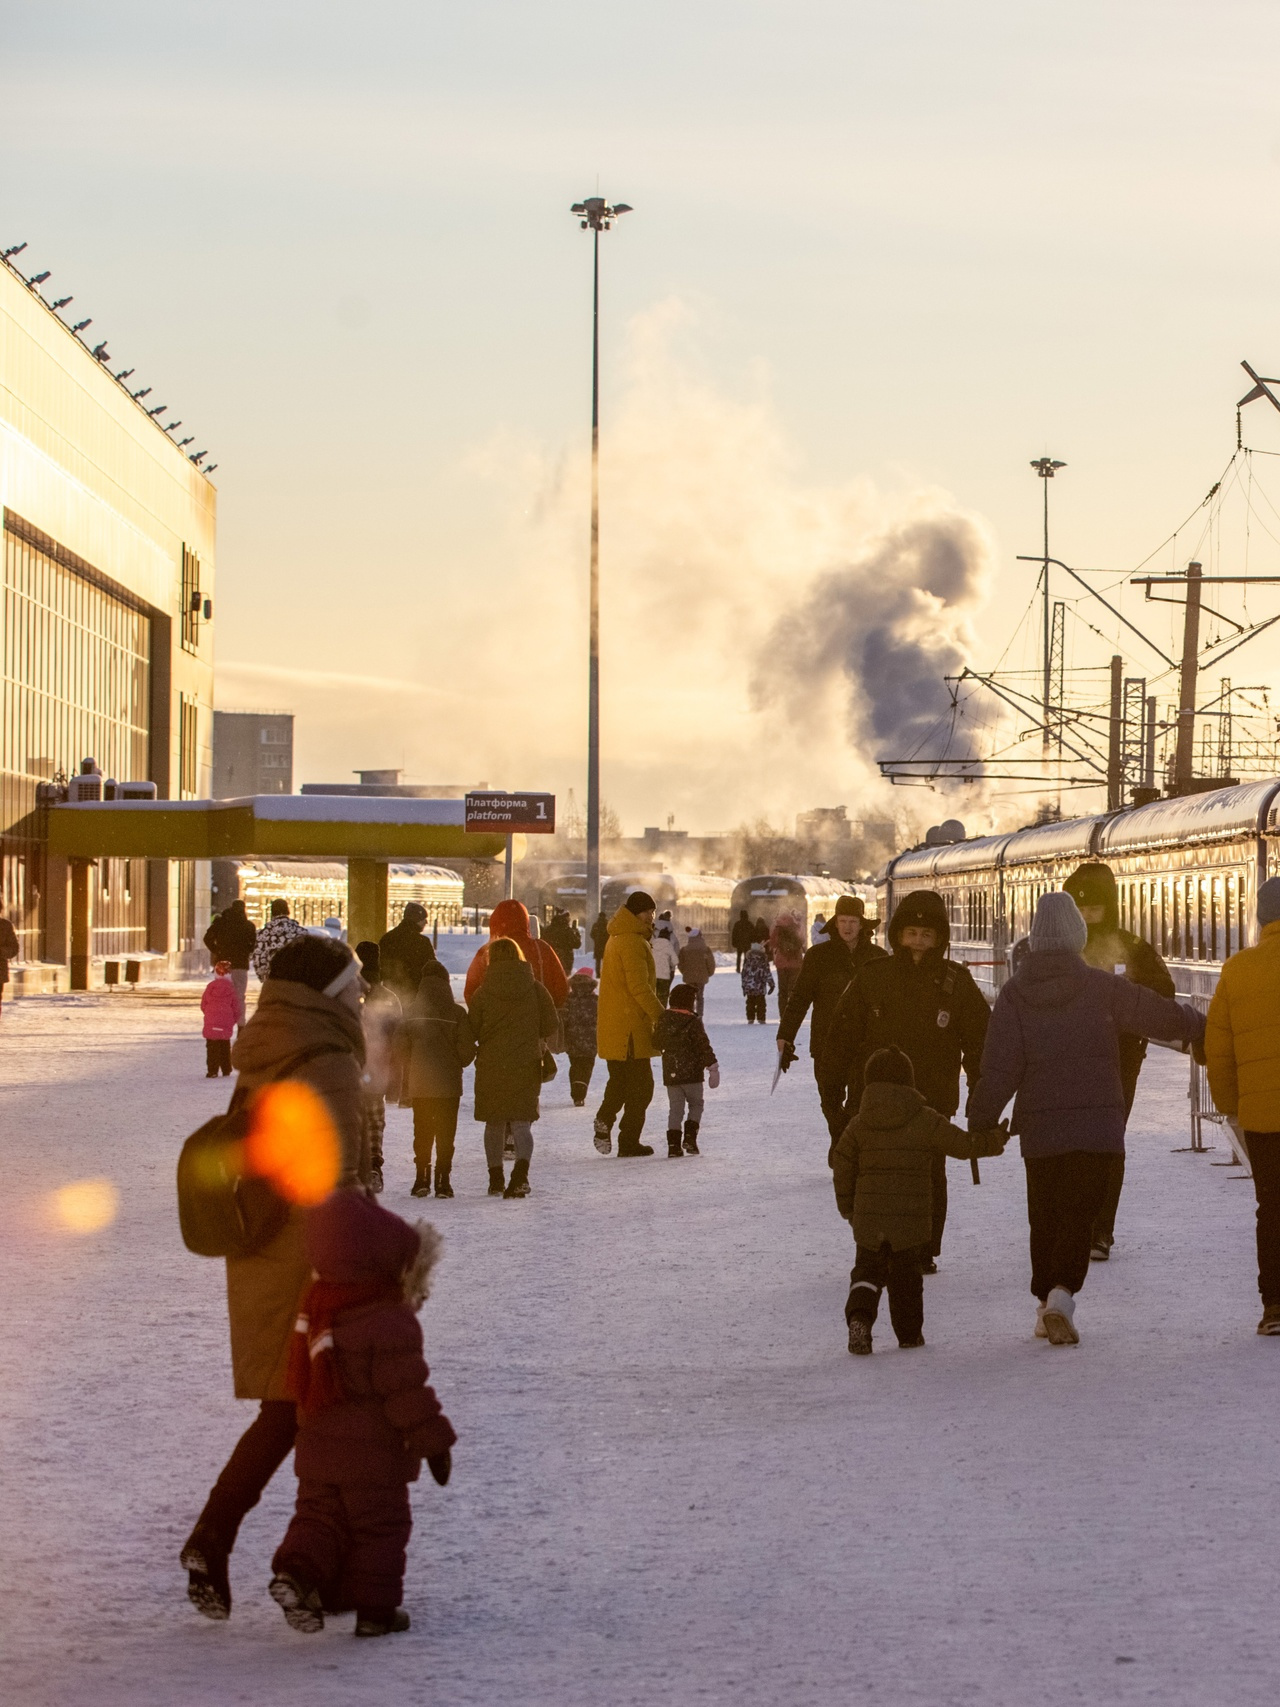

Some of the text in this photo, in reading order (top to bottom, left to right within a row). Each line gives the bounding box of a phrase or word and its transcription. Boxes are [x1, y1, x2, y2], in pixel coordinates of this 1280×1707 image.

[466, 798, 527, 809] Платформа
[536, 801, 547, 819] 1
[467, 811, 512, 821] platform
